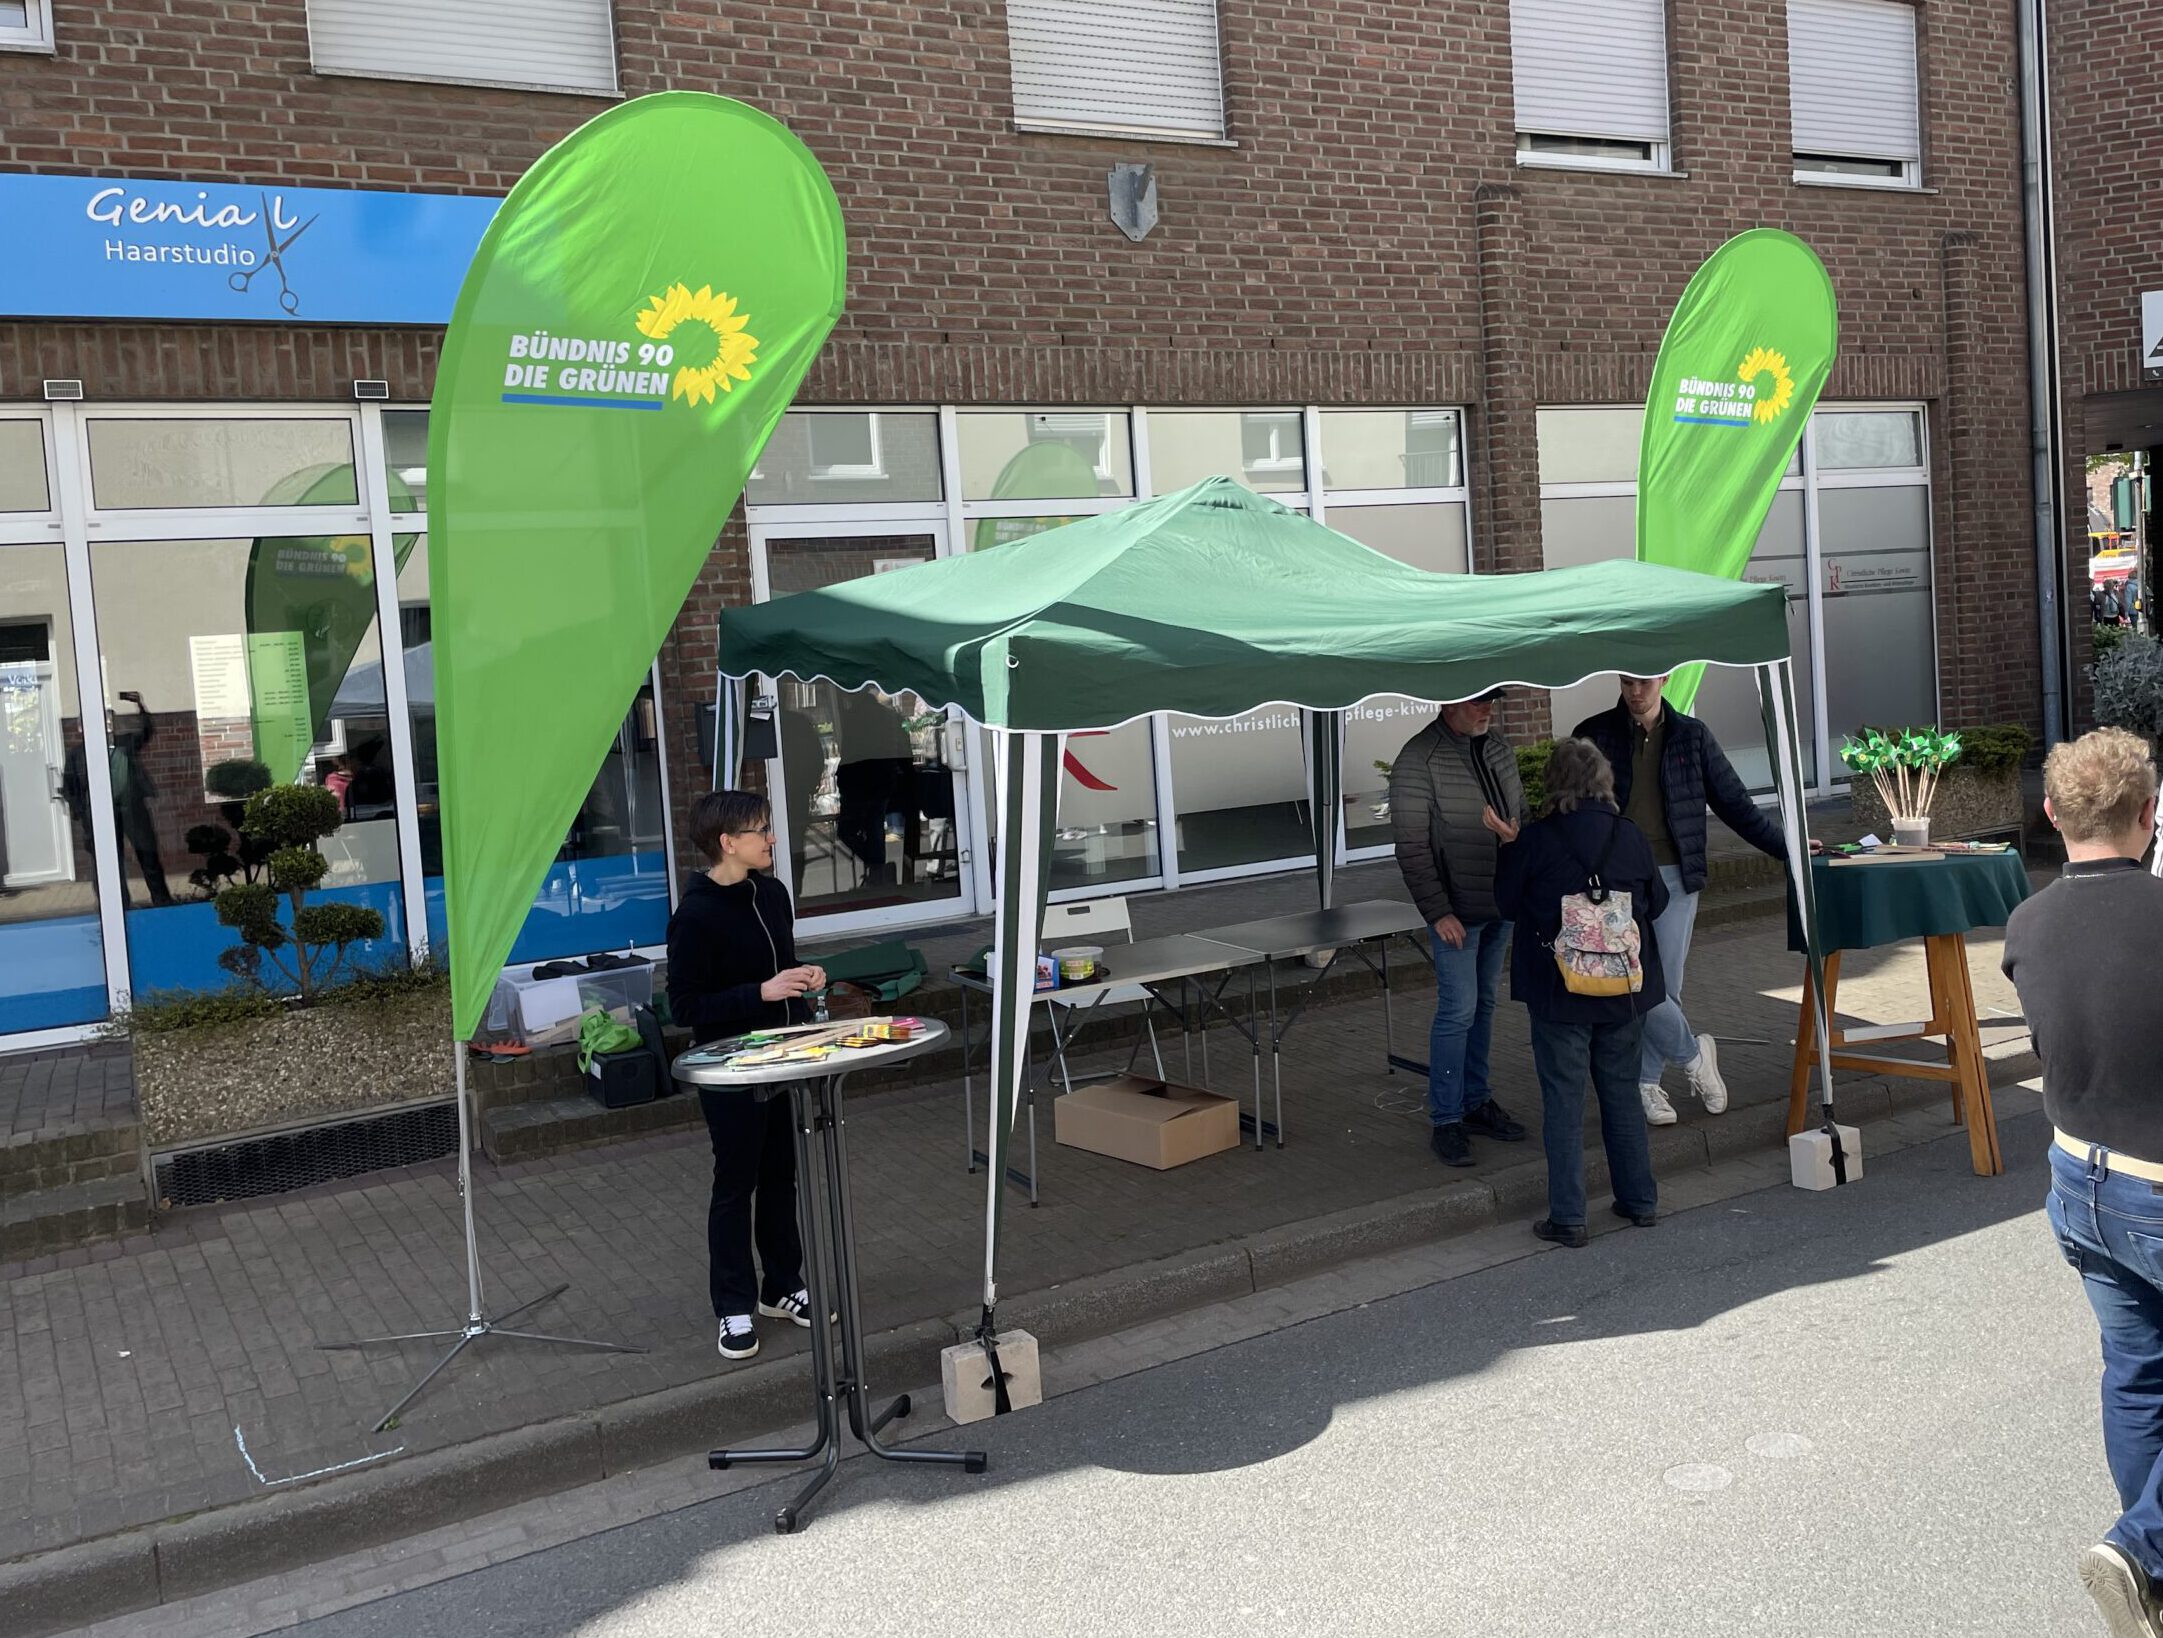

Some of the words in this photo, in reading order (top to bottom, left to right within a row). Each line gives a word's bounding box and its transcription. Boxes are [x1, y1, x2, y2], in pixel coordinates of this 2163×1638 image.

[105, 239, 256, 266] Haarstudio
[509, 330, 631, 364] BÜNDNIS
[638, 343, 674, 367] 90
[504, 363, 550, 389] DIE
[558, 363, 669, 396] GRÜNEN
[1679, 376, 1736, 399] BÜNDNIS
[1738, 384, 1756, 400] 90
[1675, 397, 1696, 413] DIE
[1699, 397, 1753, 418] GRÜNEN
